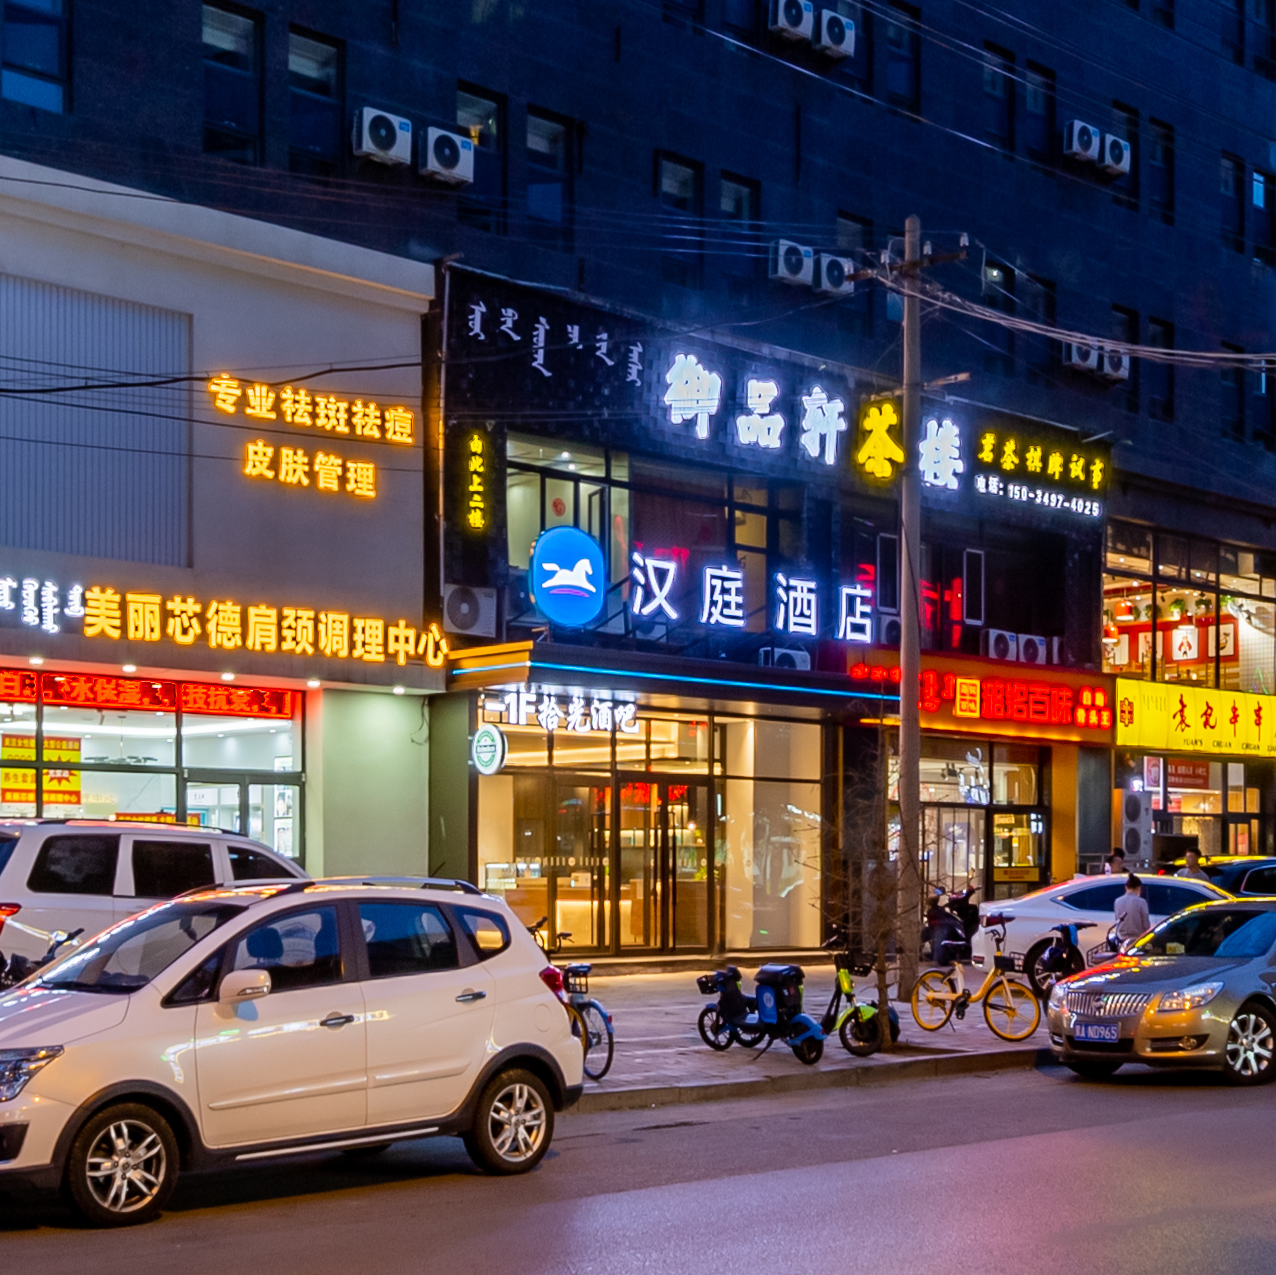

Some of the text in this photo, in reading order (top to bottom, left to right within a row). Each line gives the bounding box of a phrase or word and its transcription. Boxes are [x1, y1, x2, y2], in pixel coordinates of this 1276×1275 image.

[208, 374, 417, 445] 专业祛斑祛痘
[664, 352, 963, 490] 御品轩茶楼
[243, 439, 377, 499] 皮肤管理
[466, 433, 486, 528] 由此上二楼
[82, 586, 449, 669] 美丽芯德肩颈调理中心
[631, 551, 874, 643] 汉庭酒店
